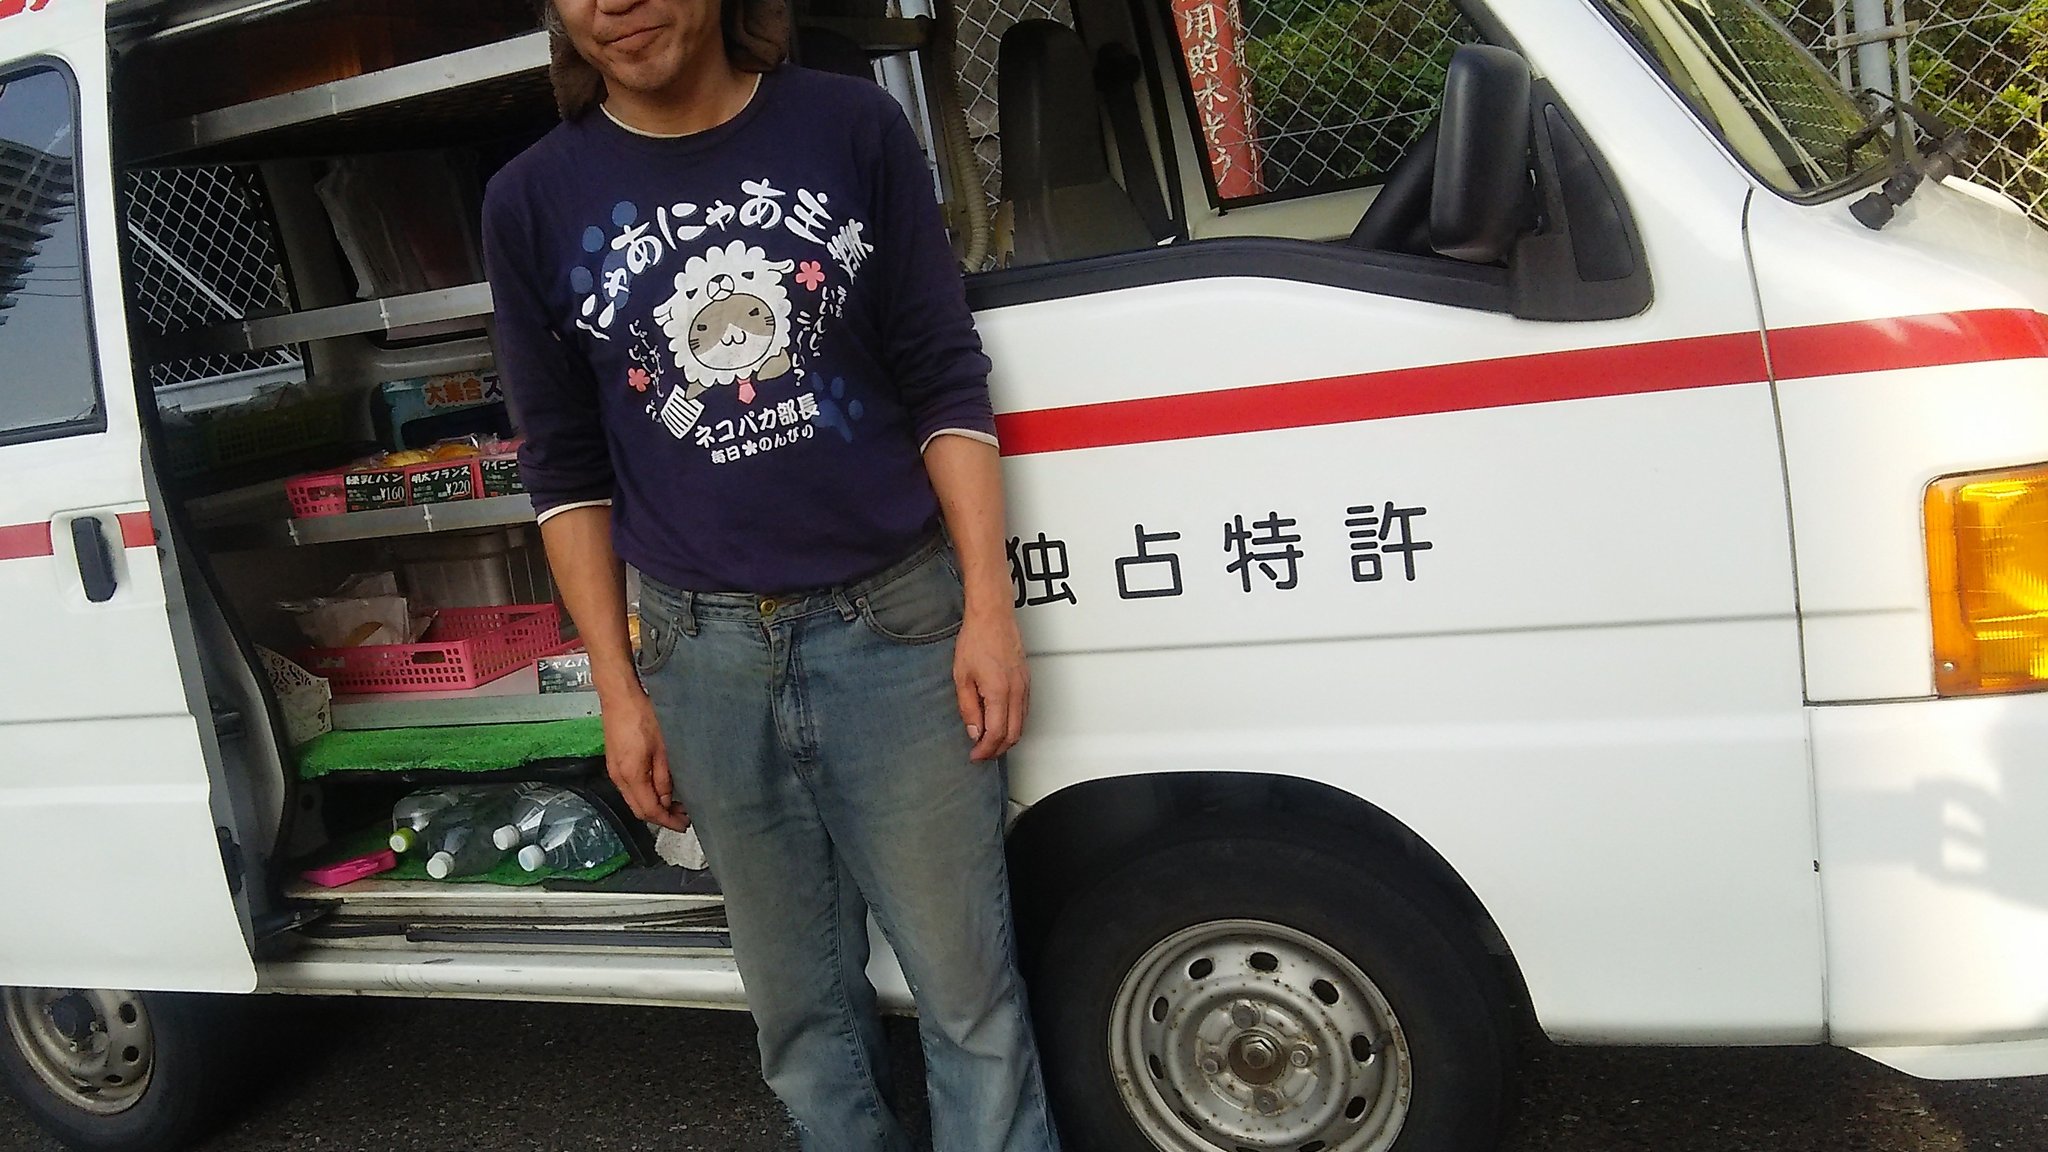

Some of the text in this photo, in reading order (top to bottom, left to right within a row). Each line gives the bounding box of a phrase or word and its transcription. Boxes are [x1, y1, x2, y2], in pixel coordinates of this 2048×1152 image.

[694, 392, 820, 449] ネコパカ部長
[411, 465, 471, 484] 明太フランス
